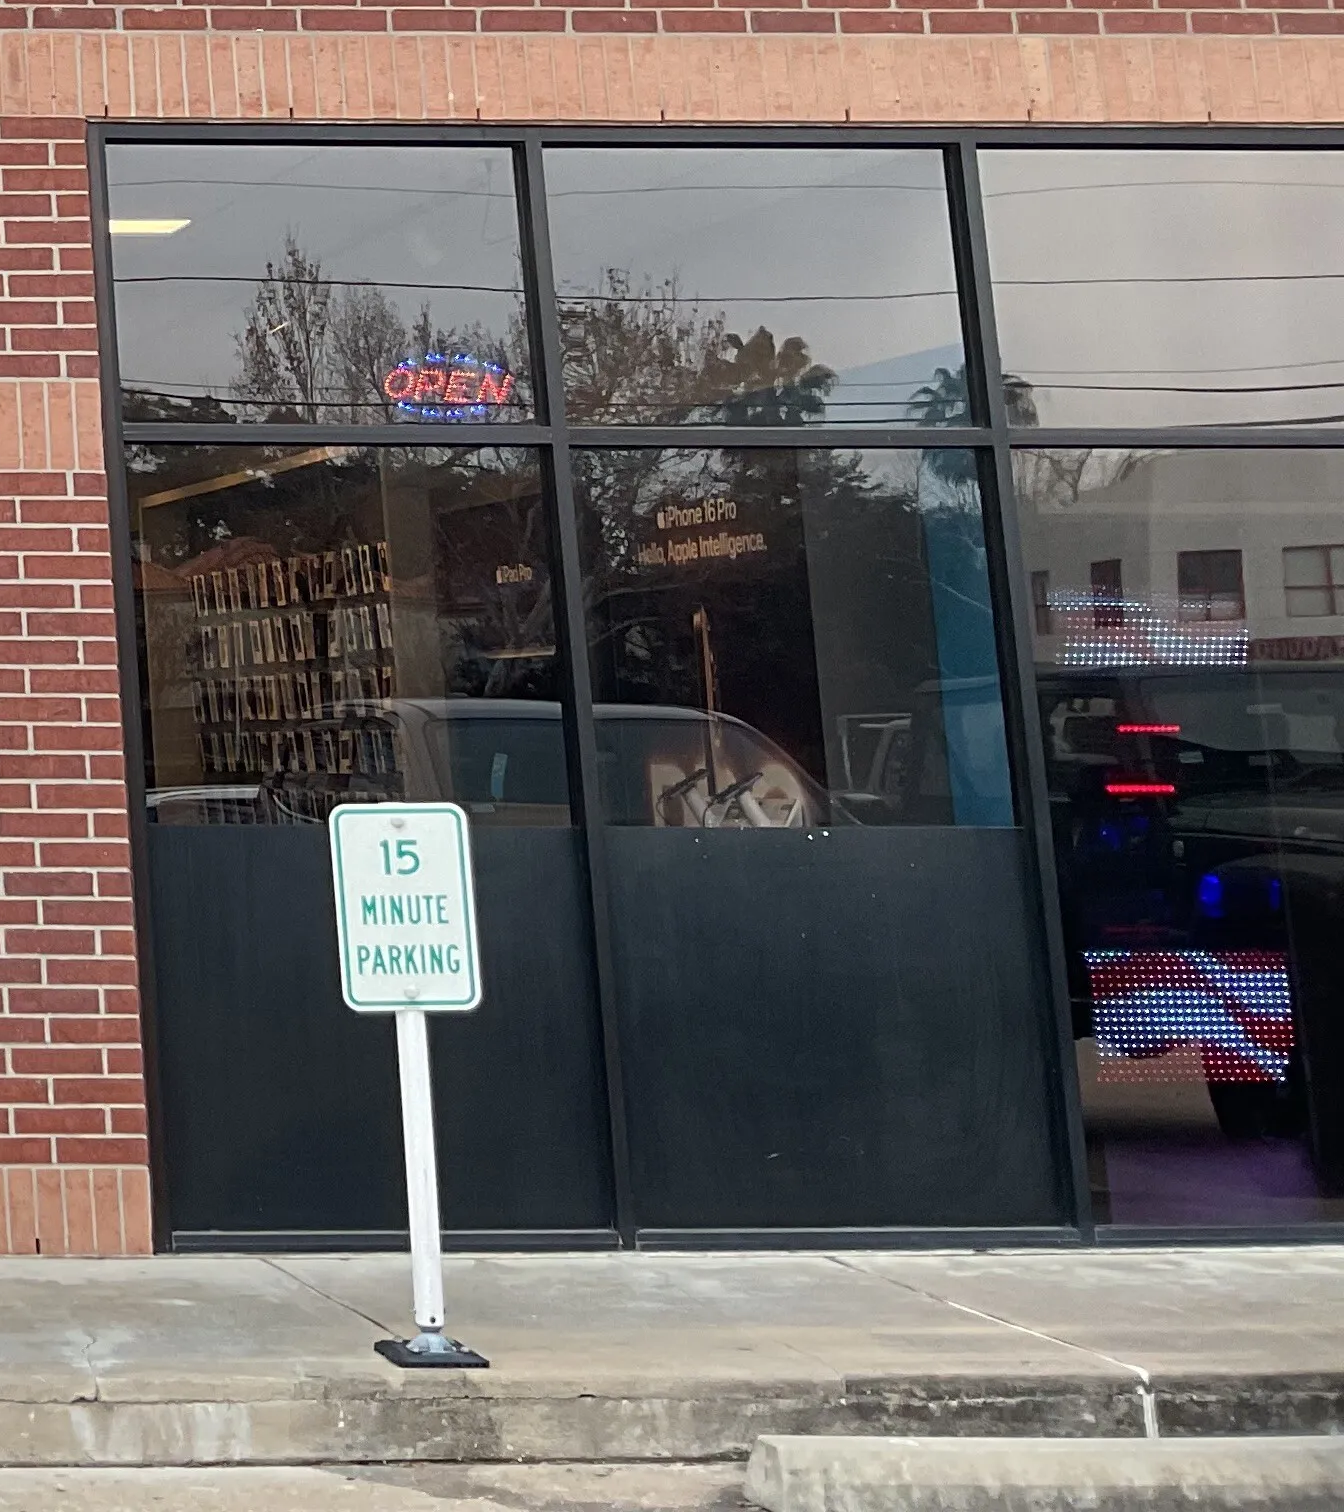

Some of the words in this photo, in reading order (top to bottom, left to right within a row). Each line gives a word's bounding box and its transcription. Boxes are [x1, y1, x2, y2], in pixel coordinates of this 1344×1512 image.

[384, 367, 514, 404] OPEN
[665, 505, 702, 528] iPhone
[703, 499, 716, 522] 16
[716, 497, 737, 520] Pro
[638, 542, 667, 566] Hello,
[667, 537, 698, 565] Apple
[699, 532, 767, 560] Intelligence.
[379, 839, 420, 875] 15
[361, 895, 449, 925] MINUTE
[357, 944, 460, 975] PARKING
